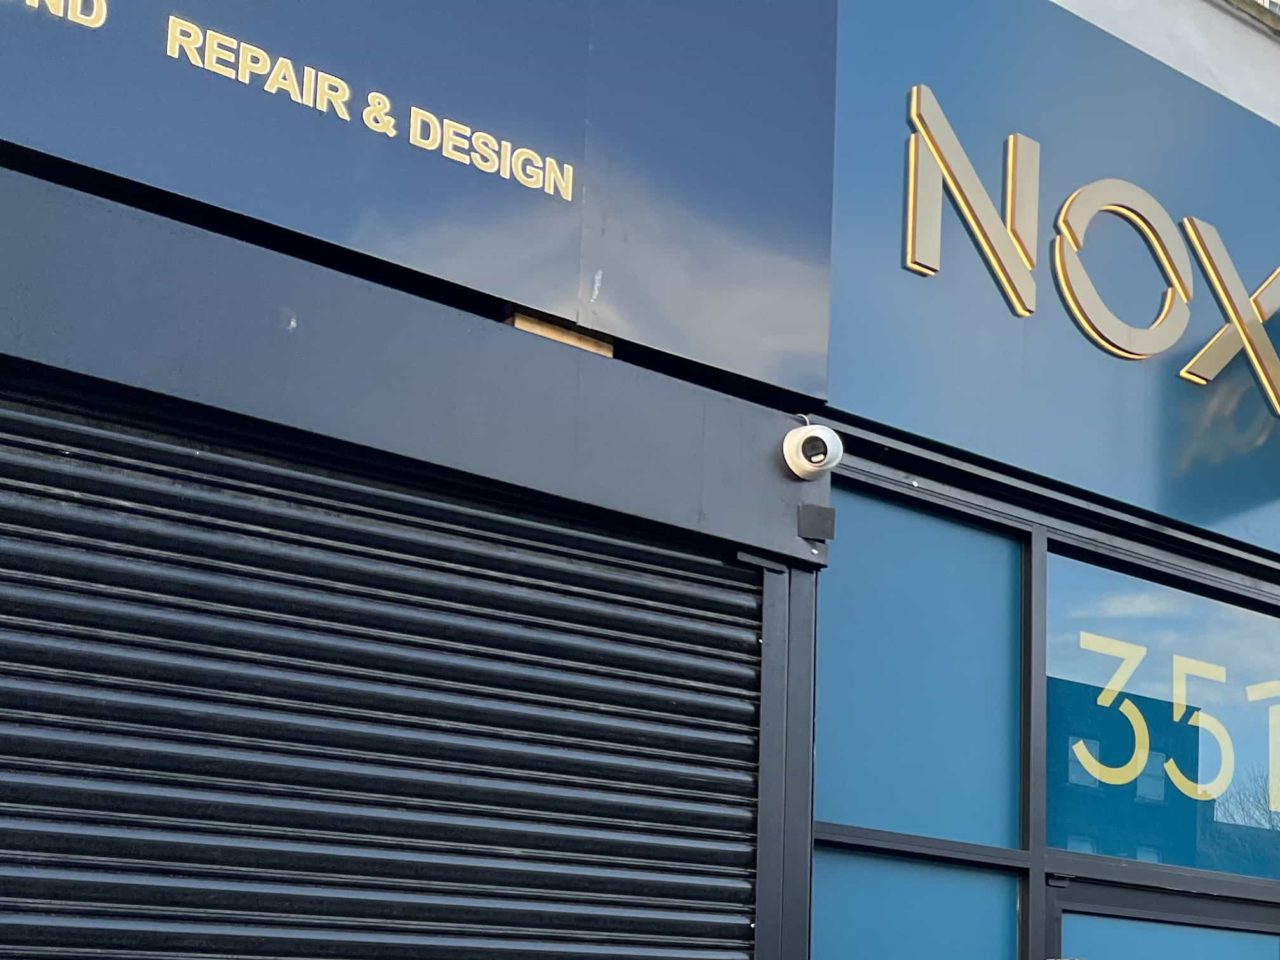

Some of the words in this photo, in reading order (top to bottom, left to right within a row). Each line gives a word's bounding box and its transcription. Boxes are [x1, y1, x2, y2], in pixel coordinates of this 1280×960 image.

[167, 16, 350, 121] REPAIR
[363, 92, 397, 137] &
[410, 106, 573, 201] DESIGN
[1072, 631, 1280, 812] 351
